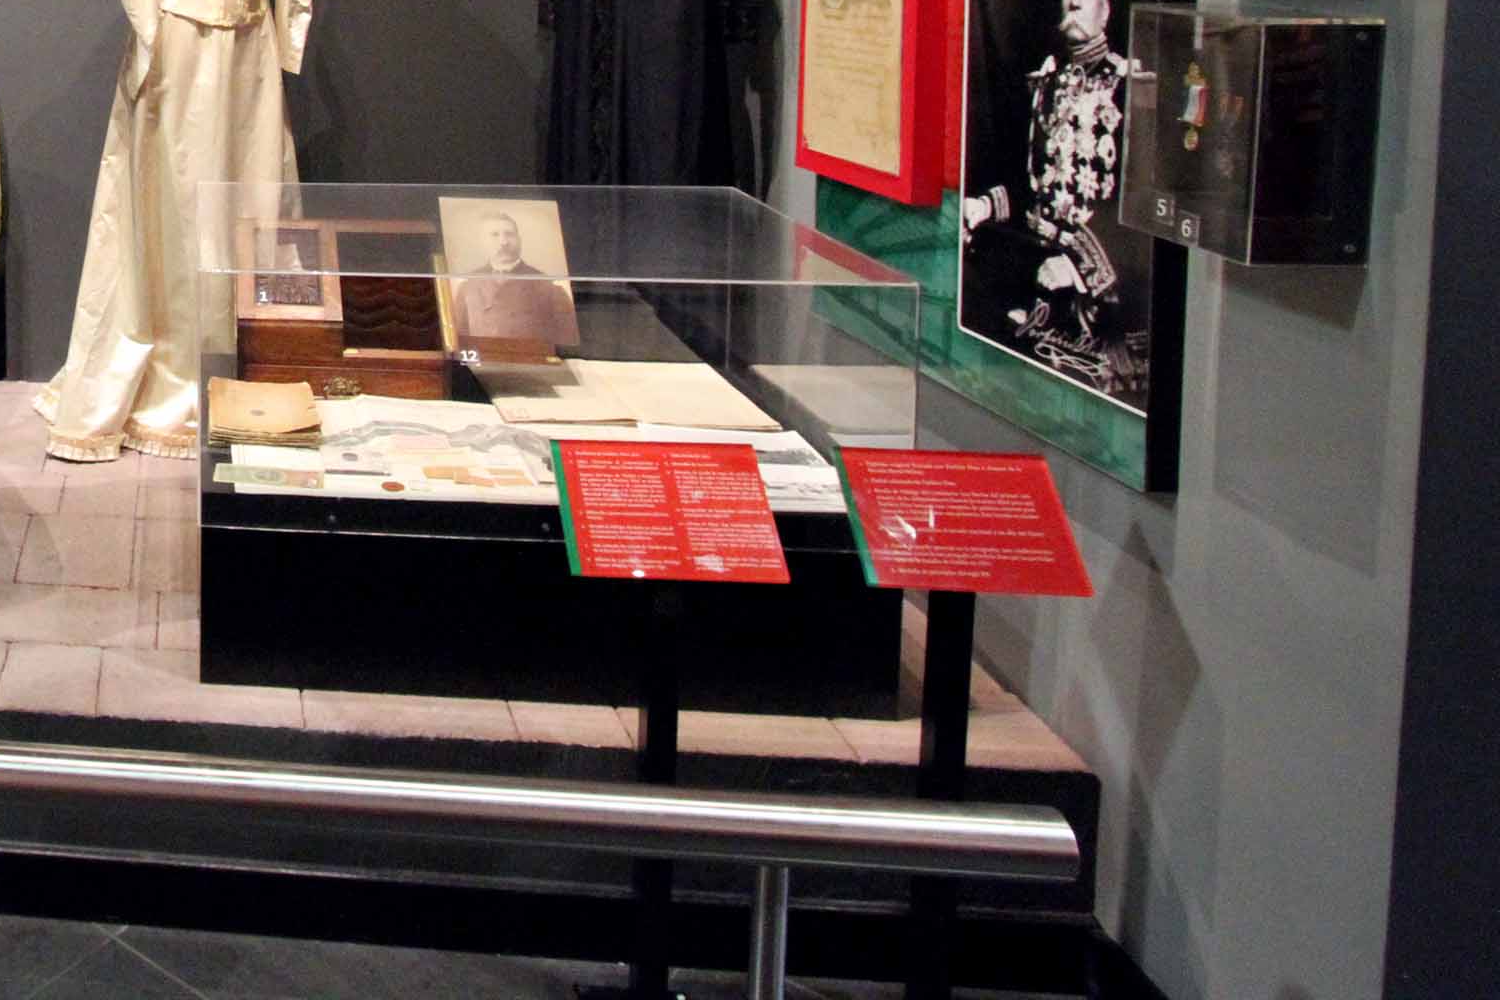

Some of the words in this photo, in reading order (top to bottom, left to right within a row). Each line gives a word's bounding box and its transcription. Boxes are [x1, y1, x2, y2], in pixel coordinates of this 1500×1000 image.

[1156, 198, 1166, 216] 5
[1180, 218, 1191, 237] 6
[259, 290, 268, 302] 1
[460, 350, 478, 363] 12
